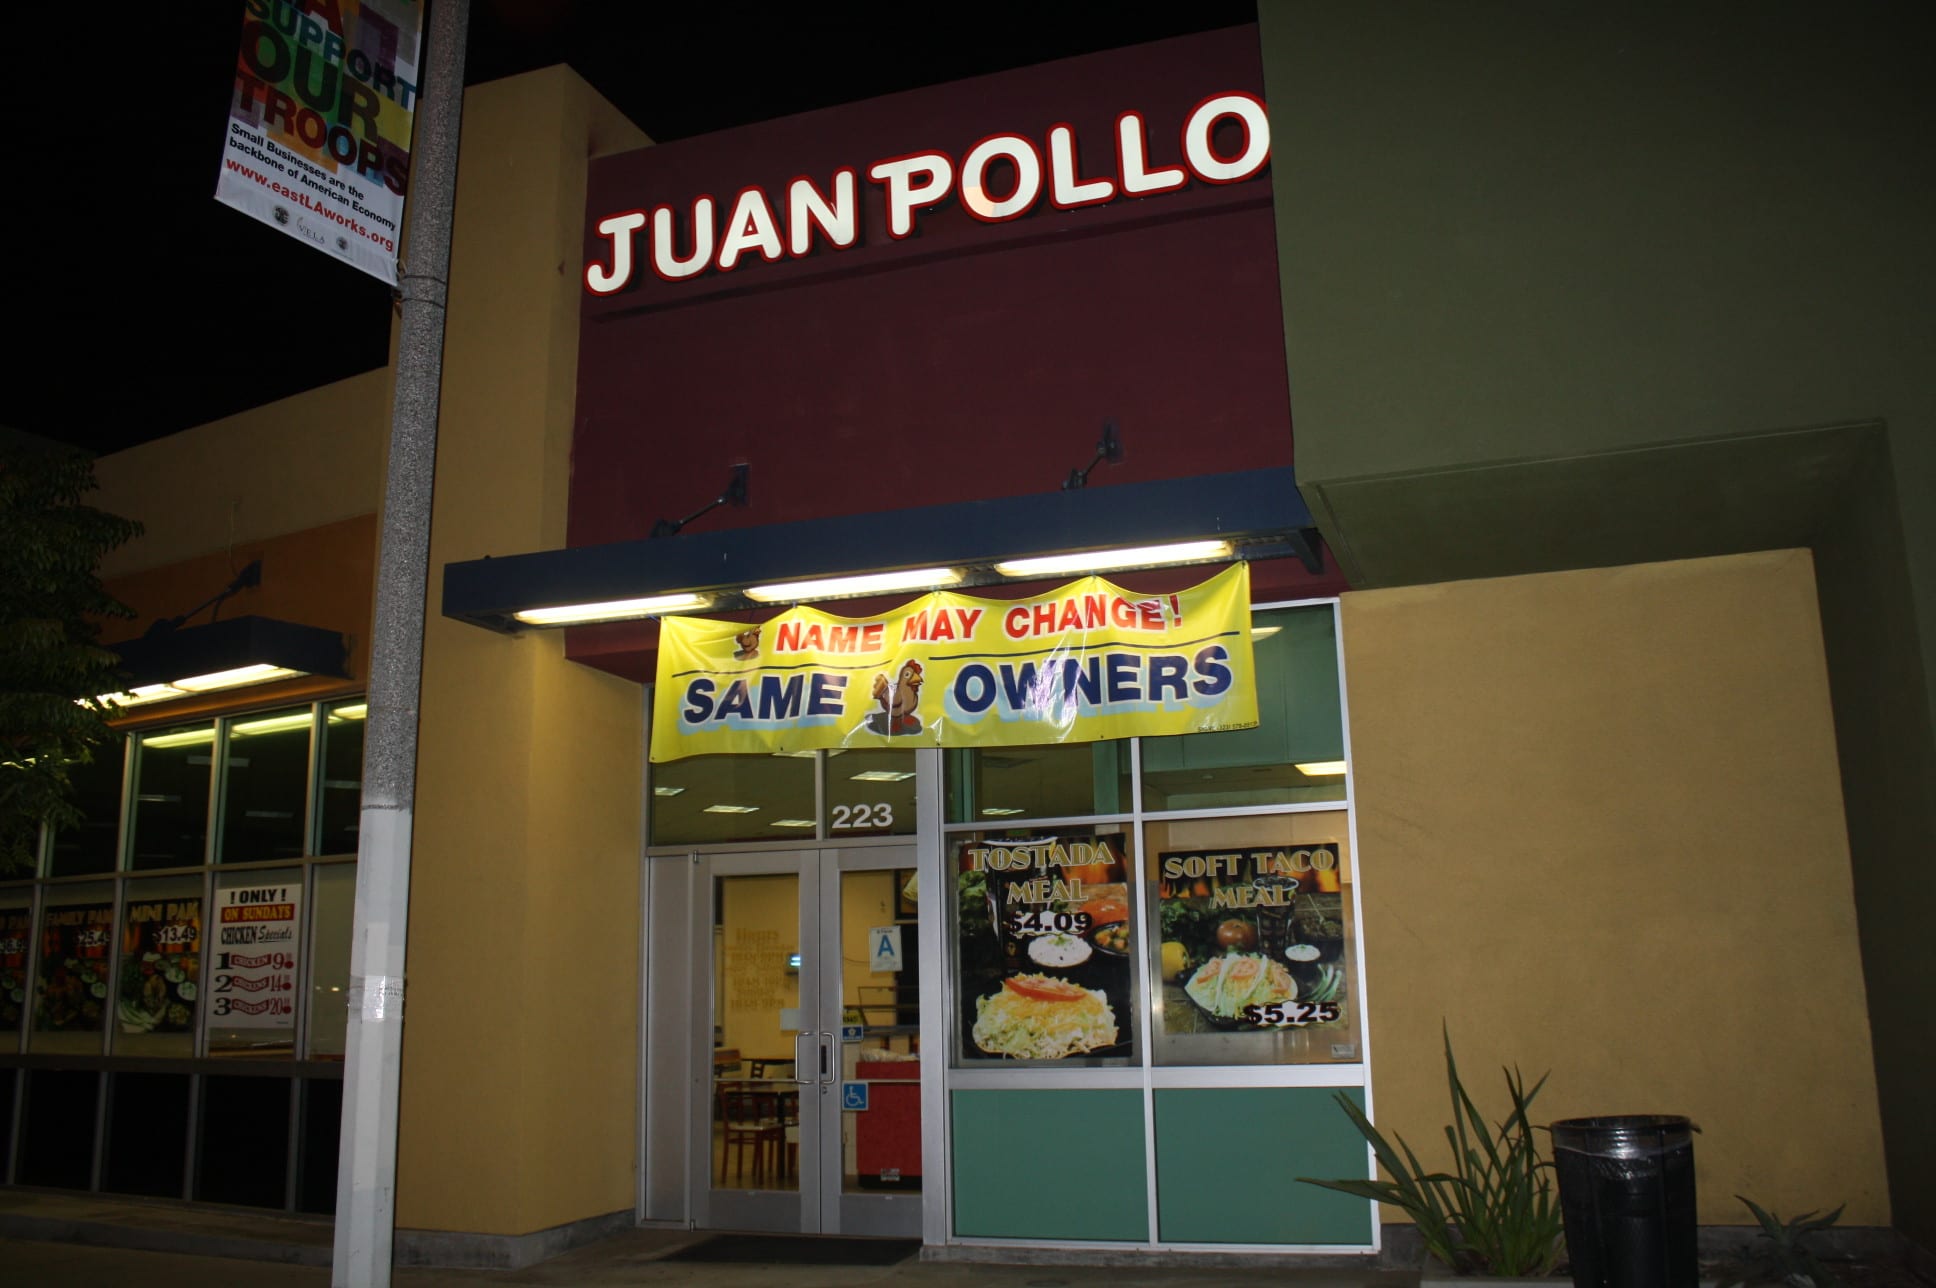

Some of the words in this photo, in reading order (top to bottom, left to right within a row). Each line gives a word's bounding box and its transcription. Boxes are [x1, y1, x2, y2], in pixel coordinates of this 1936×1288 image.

[241, 20, 380, 143] OUR
[236, 71, 409, 197] TROOPS
[231, 123, 264, 147] Small
[267, 141, 327, 181] Businesses
[329, 176, 345, 190] are
[348, 184, 365, 200] the
[229, 137, 284, 171] backbone
[287, 167, 299, 180] of
[301, 174, 350, 206] American
[352, 202, 397, 231] Economy
[584, 167, 859, 295] JUAN
[869, 94, 1271, 238] POLLO
[226, 158, 394, 252] www.eastLAworks.org
[776, 621, 885, 653] NAME
[902, 609, 983, 642] MAY
[1005, 594, 1183, 639] CHANGE!
[683, 673, 849, 724] SAME
[954, 645, 1232, 713] OWNERS
[831, 803, 894, 829] 223
[968, 842, 1116, 872] TOSTADA
[1164, 854, 1243, 879] SOFT
[1251, 849, 1335, 875] TACO
[239, 889, 277, 904] ONLY
[1007, 878, 1089, 905] MEAL
[1208, 884, 1291, 910] MEAL
[223, 907, 240, 921] ON
[242, 905, 292, 921] SUNDAYS
[1010, 911, 1093, 934] $4.09
[221, 926, 258, 944] CHICKEN
[877, 934, 896, 958] A
[216, 952, 233, 969] 1
[214, 975, 232, 992] 2
[213, 997, 231, 1015] 3
[1242, 1001, 1341, 1025] $5.25
